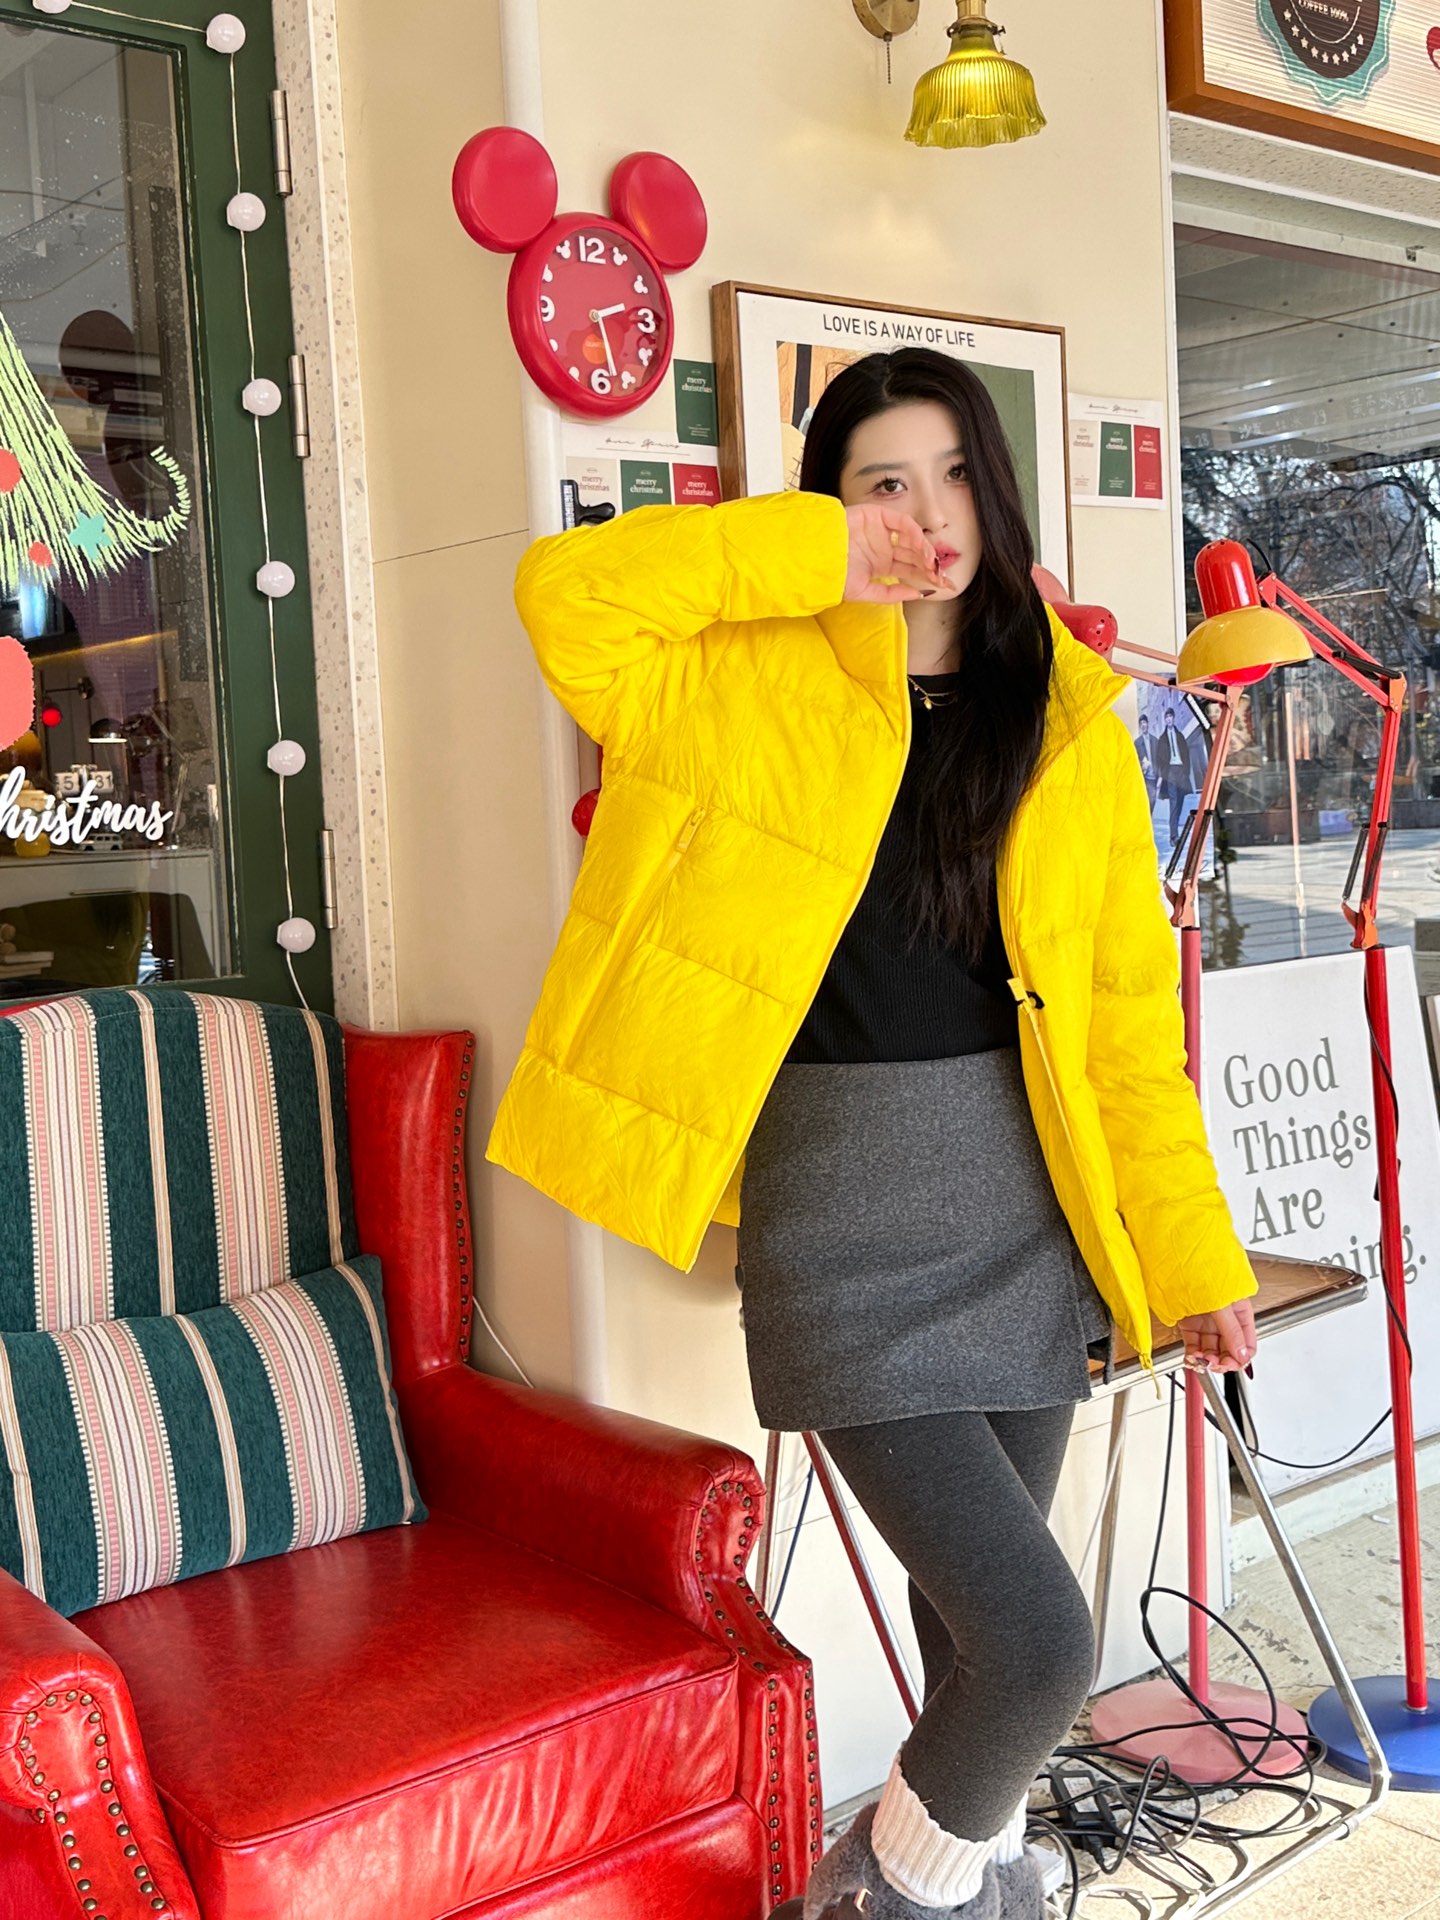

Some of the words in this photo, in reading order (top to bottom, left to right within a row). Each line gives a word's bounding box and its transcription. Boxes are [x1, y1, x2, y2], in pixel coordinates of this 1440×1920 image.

[578, 235, 606, 265] 12
[540, 295, 556, 322] 9
[637, 308, 656, 333] 3
[823, 314, 861, 335] LOVE
[864, 320, 877, 336] IS
[880, 322, 891, 338] A
[892, 322, 923, 342] WAY
[925, 327, 943, 343] OF
[946, 329, 976, 348] LIFE
[591, 368, 611, 395] 6
[687, 376, 706, 387] merry
[581, 476, 603, 485] merry
[629, 485, 663, 495] christmas
[636, 479, 657, 488] merry
[682, 487, 714, 497] christmas
[687, 481, 706, 491] merry
[0, 765, 174, 846] hristmas
[1223, 1036, 1340, 1109] Good
[1232, 1109, 1372, 1175] Things
[1248, 1186, 1326, 1245] Are
